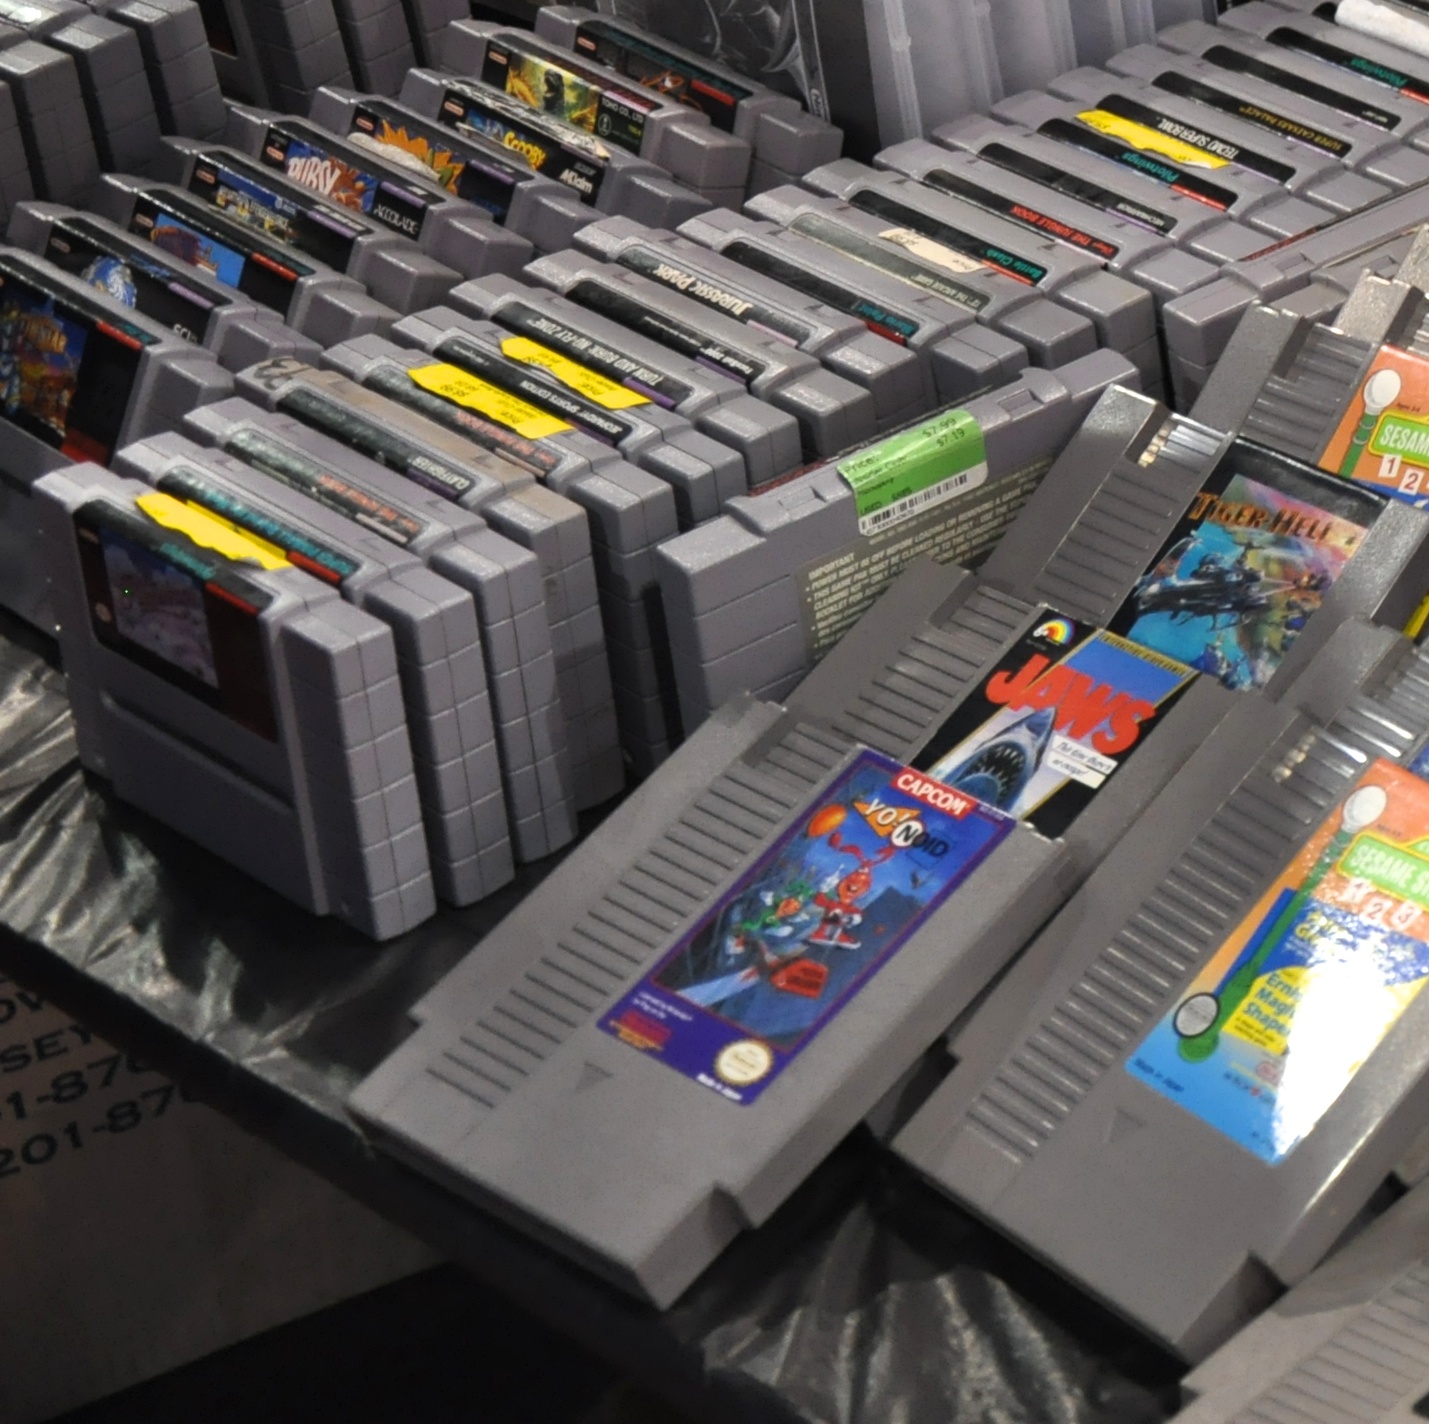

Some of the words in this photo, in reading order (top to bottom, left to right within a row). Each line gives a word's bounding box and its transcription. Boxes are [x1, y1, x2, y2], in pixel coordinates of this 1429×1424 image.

[1350, 57, 1409, 89] Pilotwings
[601, 92, 622, 110] TOHO
[1156, 116, 1189, 141] BOWL
[1211, 134, 1239, 158] TECMO
[1120, 149, 1181, 183] Pilotwings
[373, 202, 421, 237] ACCOLADE
[655, 260, 690, 290] PARK
[688, 275, 754, 317] JURASSIC
[518, 377, 548, 402] EDITION
[542, 389, 582, 417] SPORTS
[936, 427, 966, 447] $7.19
[408, 454, 471, 491] CLAYFIGHTER
[808, 552, 855, 579] IMPORTANT
[811, 571, 836, 590] POWER
[914, 525, 946, 547] LOADING
[985, 653, 1156, 755] JAWS
[896, 772, 971, 816] CAPCOM
[866, 797, 909, 830] YO!
[899, 823, 950, 859] NOID
[1350, 843, 1416, 889] SESAME
